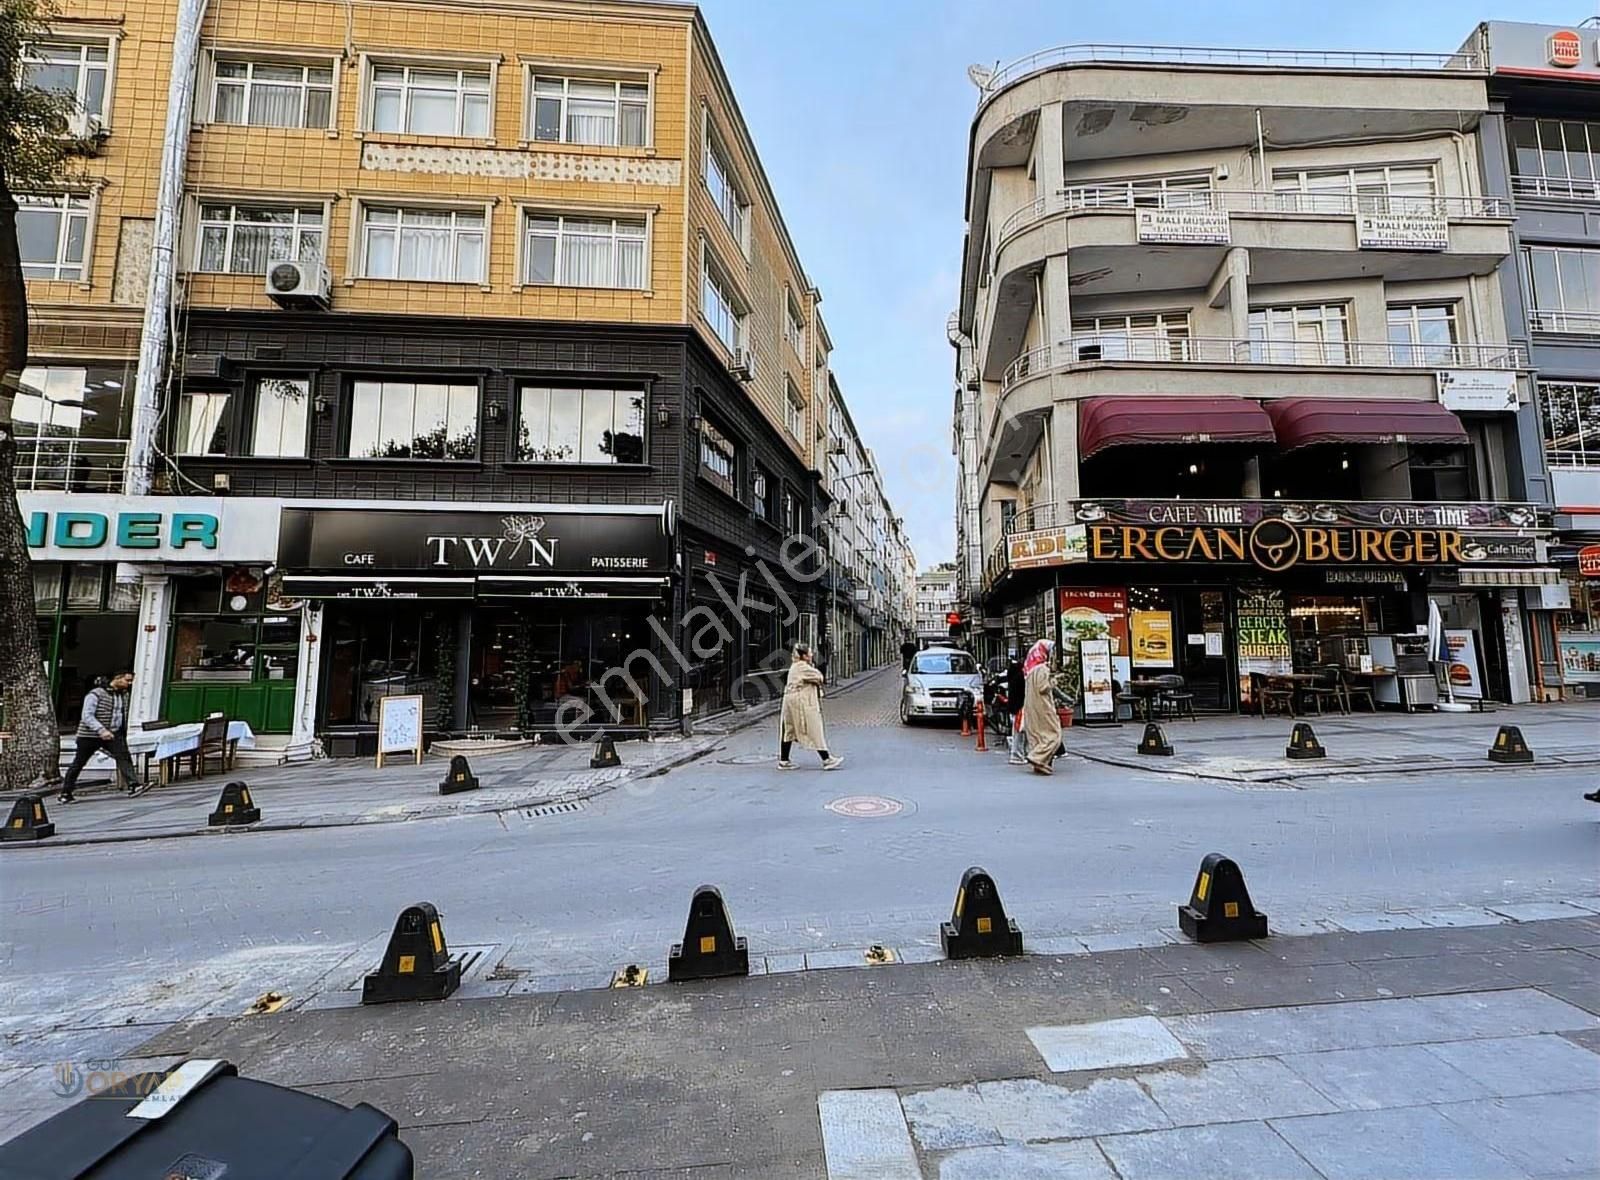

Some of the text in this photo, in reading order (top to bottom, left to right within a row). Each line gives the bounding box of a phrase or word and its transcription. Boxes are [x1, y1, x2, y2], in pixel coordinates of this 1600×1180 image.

[1554, 47, 1579, 57] KING
[1149, 506, 1197, 523] CAFE
[1379, 507, 1426, 525] CAFE
[1089, 526, 1466, 563] ERCAN BURGER
[1487, 544, 1534, 554] Cafe Time
[344, 553, 375, 565] CAFE
[591, 556, 649, 569] PATISSERIE
[1238, 616, 1287, 629] GERÇEK
[1239, 629, 1288, 644] STEAK
[1239, 644, 1290, 657] BURGER
